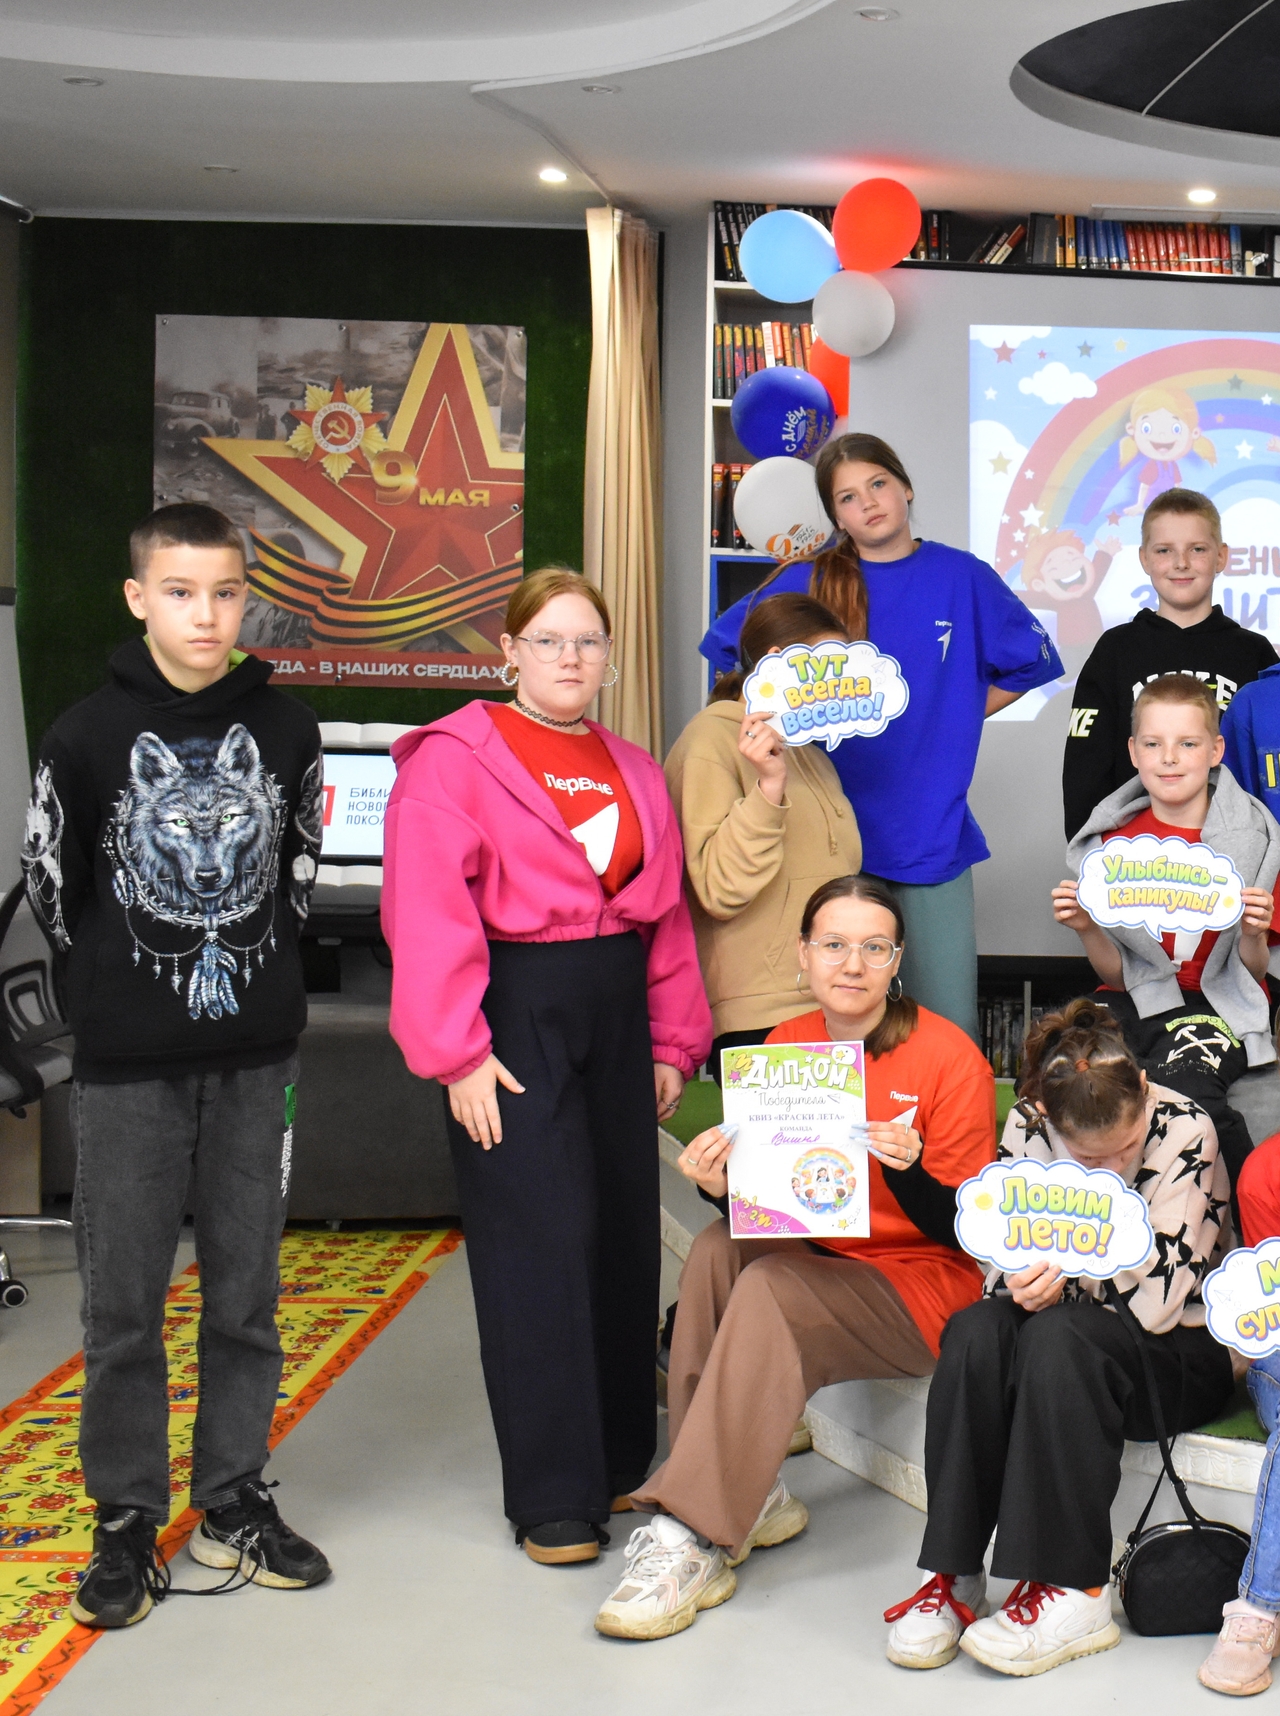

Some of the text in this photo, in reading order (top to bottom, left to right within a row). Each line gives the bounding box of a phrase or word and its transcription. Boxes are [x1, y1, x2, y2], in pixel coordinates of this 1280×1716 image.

[371, 450, 490, 508] 9 МАЯ
[272, 659, 305, 674] ЕДА
[319, 661, 334, 673] В
[337, 661, 409, 676] НАШИХ
[413, 664, 503, 679] СЕРДЦАХ
[787, 652, 850, 684] Тут
[783, 676, 872, 710] всегда
[780, 691, 885, 737] весело!
[1067, 708, 1099, 737] KE
[349, 787, 391, 798] БИБЛИ
[543, 771, 614, 796] Первые
[345, 814, 385, 826] ПОКО
[347, 800, 387, 812] НОВО
[1102, 854, 1212, 887] Улыбнись
[1108, 887, 1220, 915] каникулы!
[890, 1091, 919, 1103] Первые
[749, 1113, 845, 1122] КВИЗ «КРАСКИ ЛЕТА»
[999, 1176, 1113, 1222] Ловим
[1004, 1216, 1115, 1258] лето!
